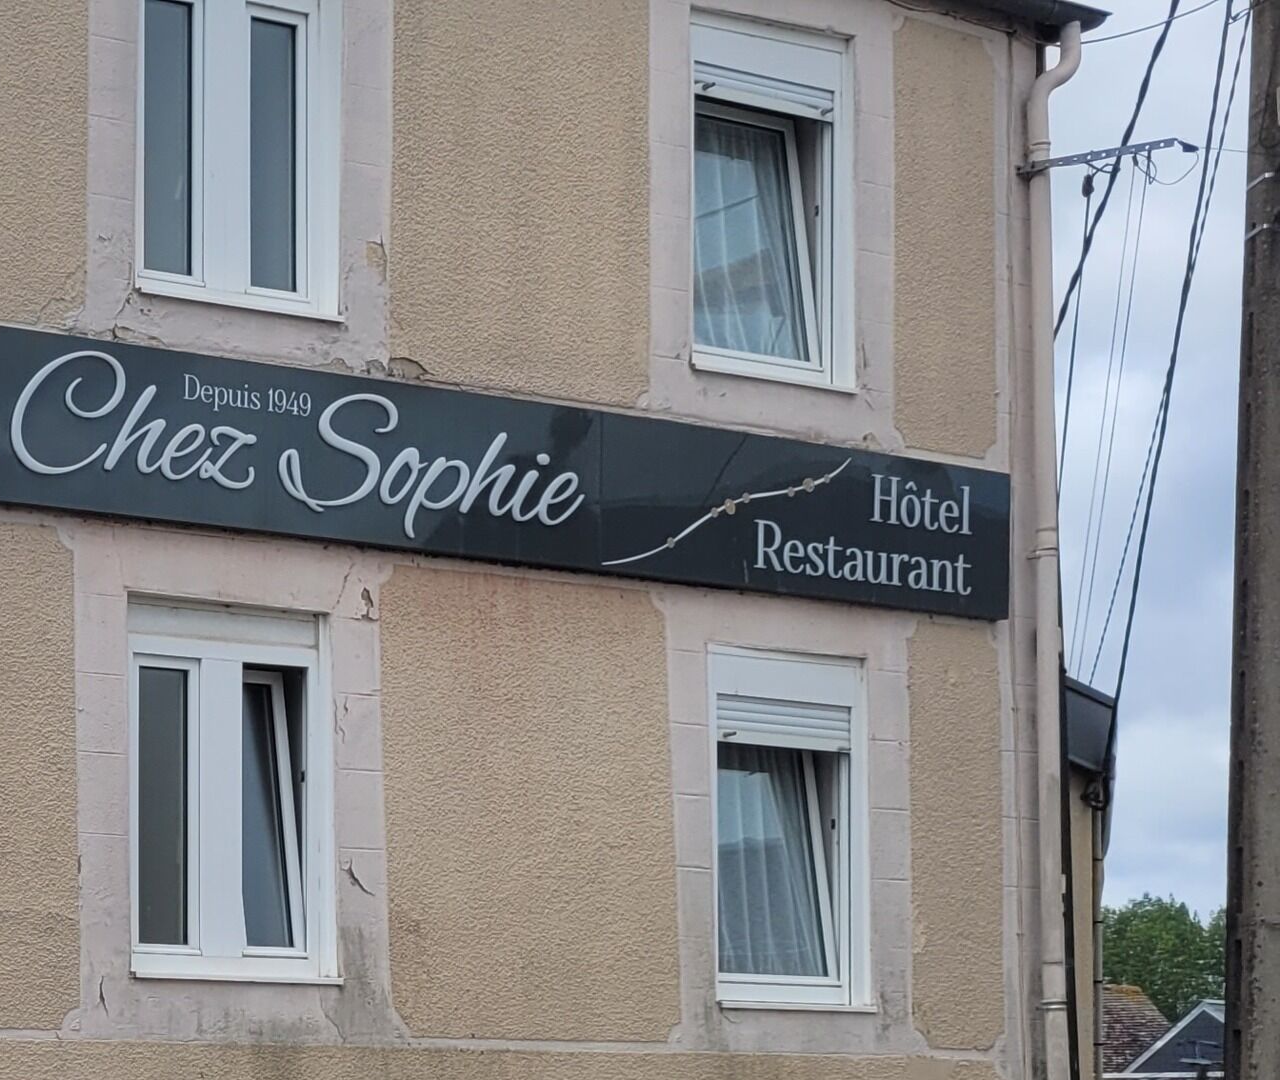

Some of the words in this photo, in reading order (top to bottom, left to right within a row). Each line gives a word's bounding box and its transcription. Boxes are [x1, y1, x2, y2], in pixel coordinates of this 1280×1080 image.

[183, 373, 261, 411] Depuis
[267, 387, 312, 417] 1949
[10, 350, 256, 490] Chez
[278, 393, 585, 539] Sophie
[870, 474, 972, 535] Hôtel
[753, 519, 972, 595] Restaurant
